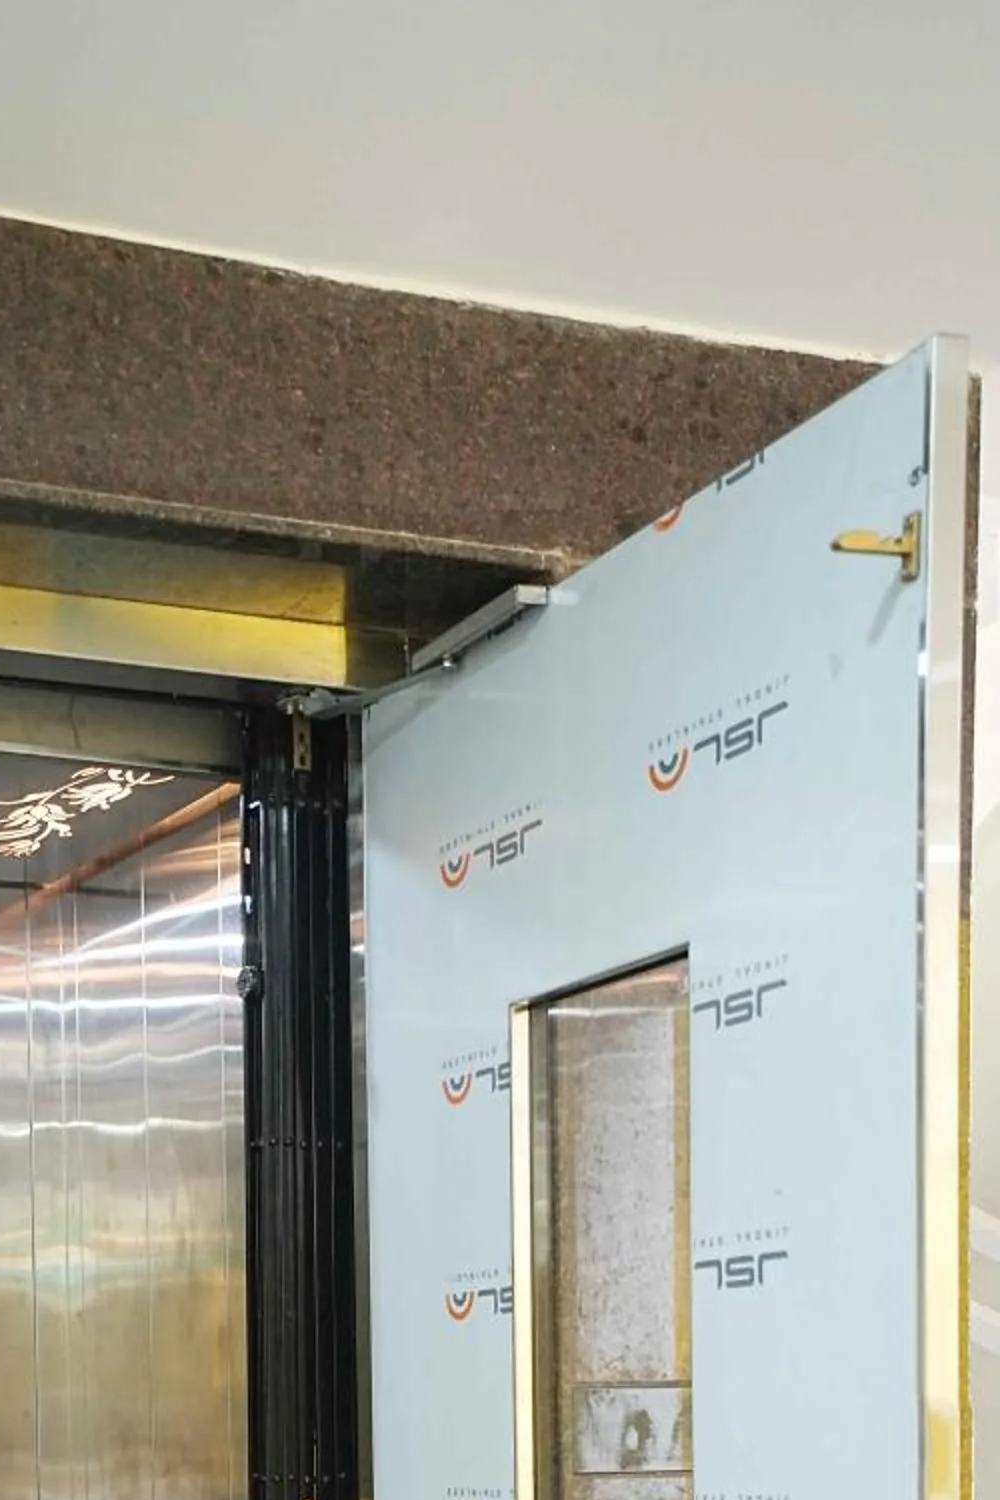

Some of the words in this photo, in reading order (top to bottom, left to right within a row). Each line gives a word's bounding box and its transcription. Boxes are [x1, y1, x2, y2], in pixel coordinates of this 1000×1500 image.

[694, 701, 788, 765] JSL
[473, 819, 543, 870] JSL
[692, 979, 787, 1030] JSL
[476, 1062, 511, 1093] SL
[695, 1251, 788, 1289] JSL
[478, 1287, 512, 1315] SL
